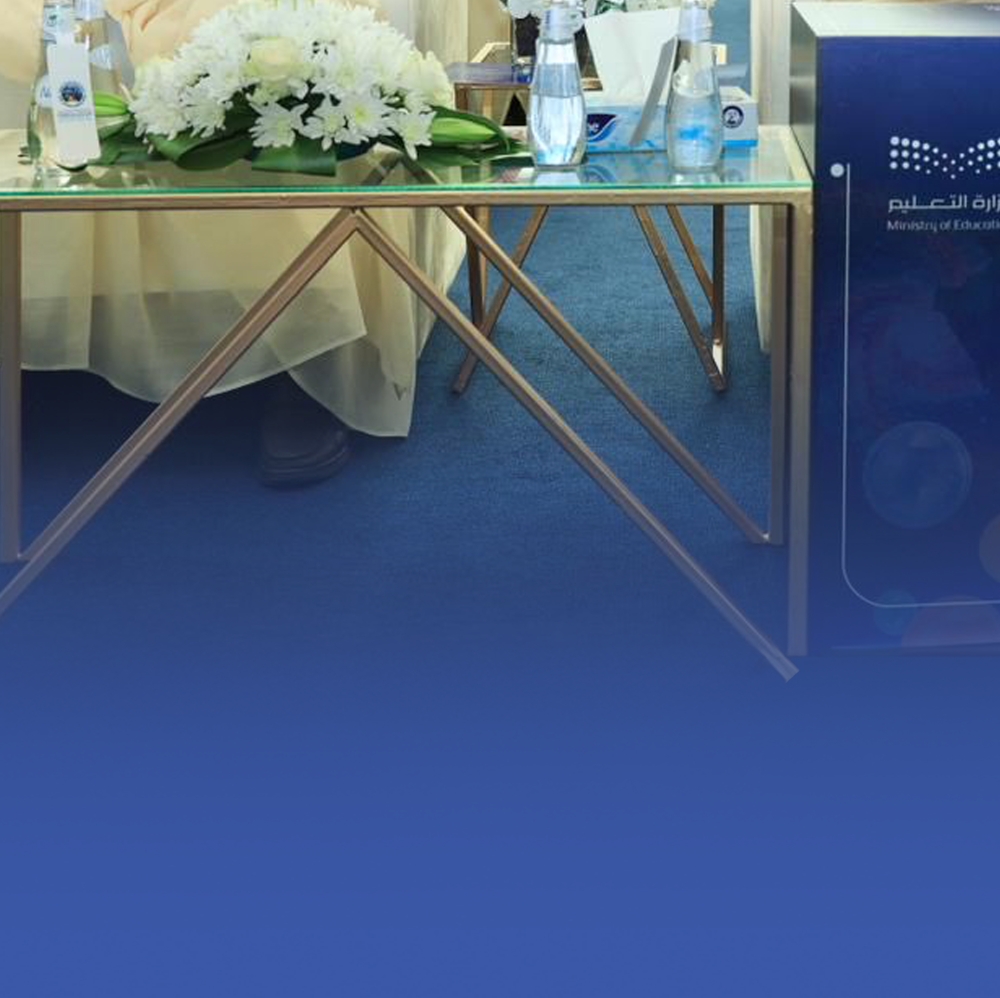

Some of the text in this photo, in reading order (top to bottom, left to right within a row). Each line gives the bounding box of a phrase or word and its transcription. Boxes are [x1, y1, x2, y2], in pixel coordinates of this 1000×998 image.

[888, 193, 968, 214] التعليم
[887, 219, 938, 232] Ministry
[939, 219, 951, 231] of
